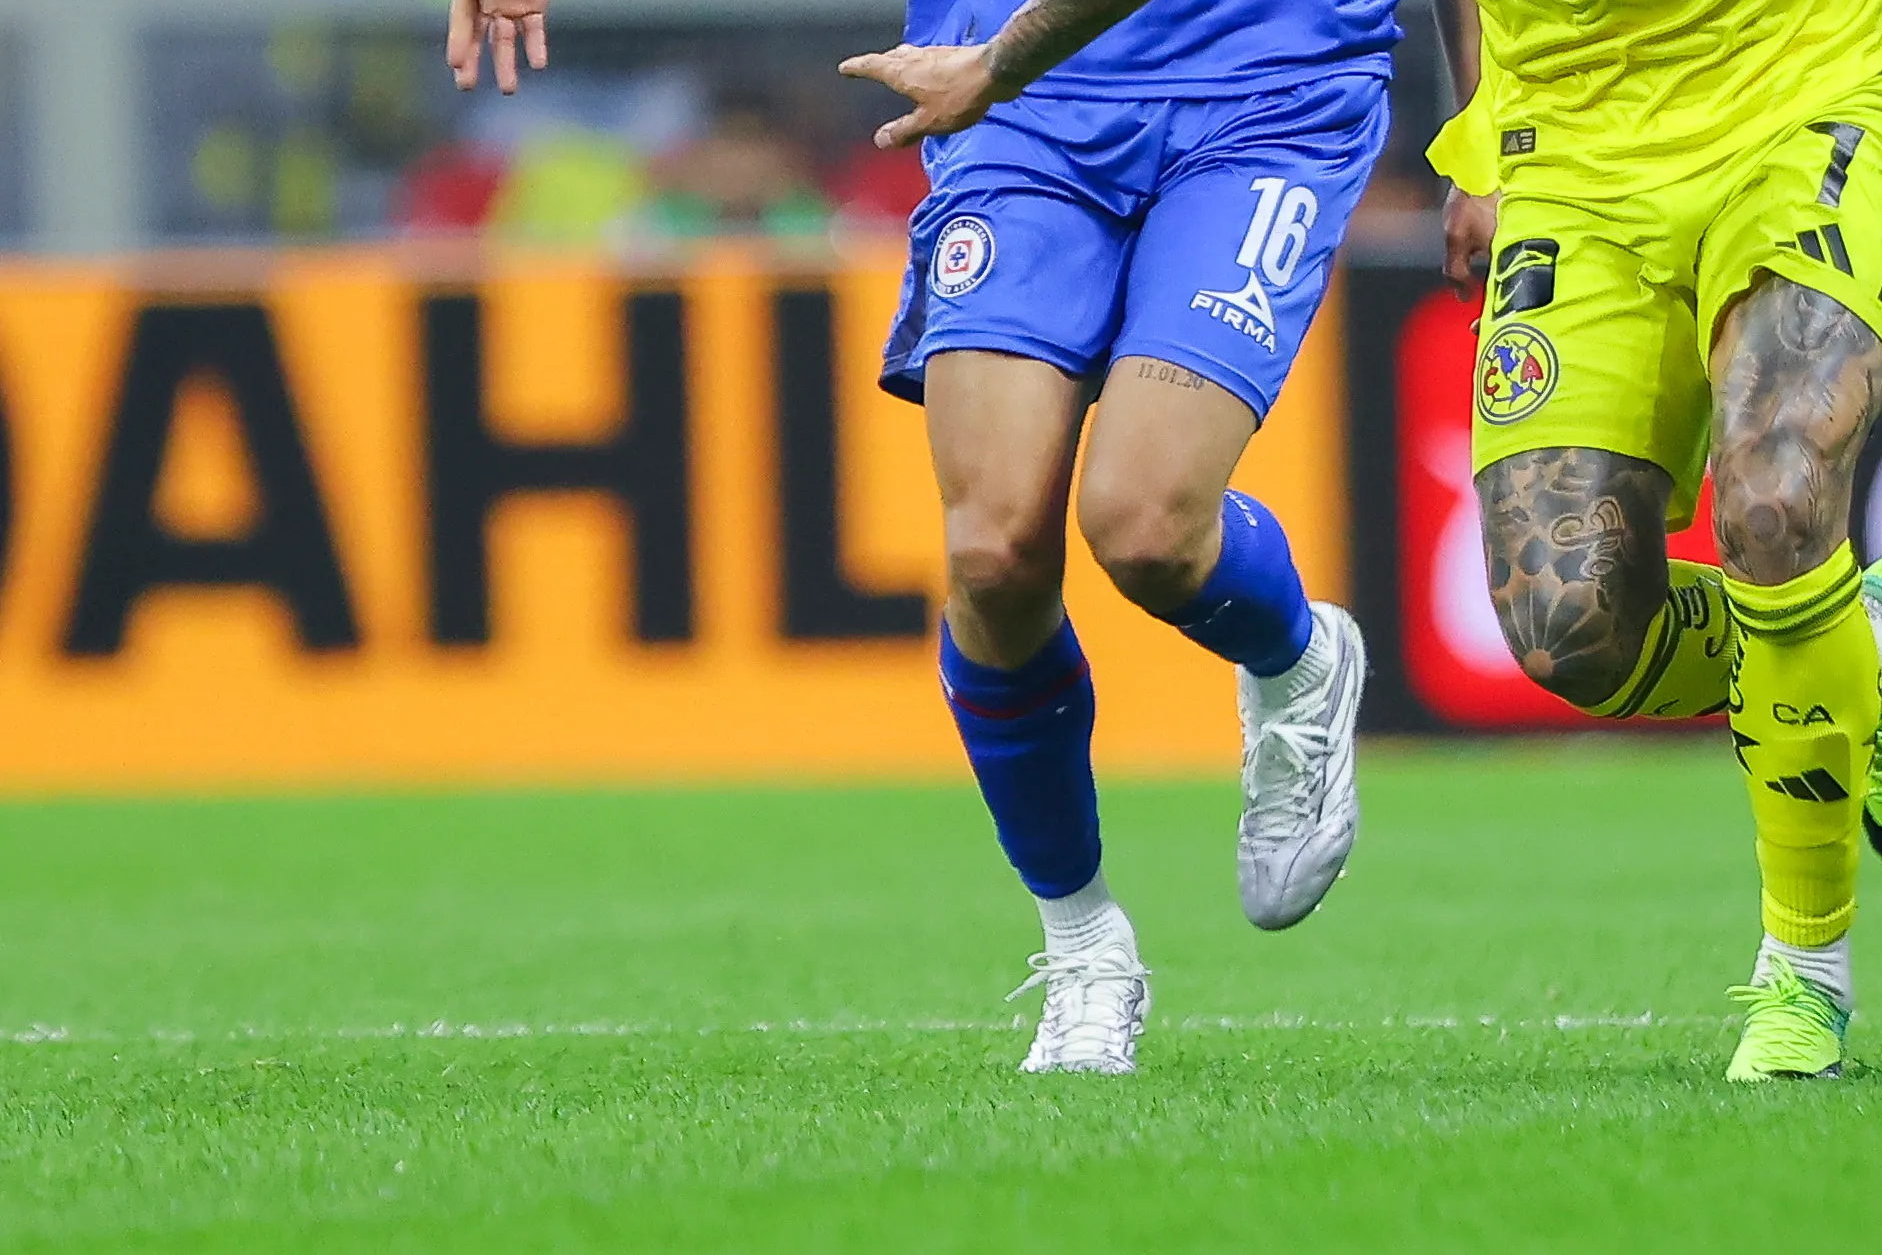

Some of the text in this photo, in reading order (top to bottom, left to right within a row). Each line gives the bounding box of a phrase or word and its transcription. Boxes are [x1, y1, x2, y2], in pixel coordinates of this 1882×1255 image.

[1804, 121, 1866, 208] 7
[1235, 176, 1319, 287] 16
[1190, 294, 1277, 354] PIRMA
[0, 290, 930, 656] AHL
[1772, 702, 1836, 727] CA
